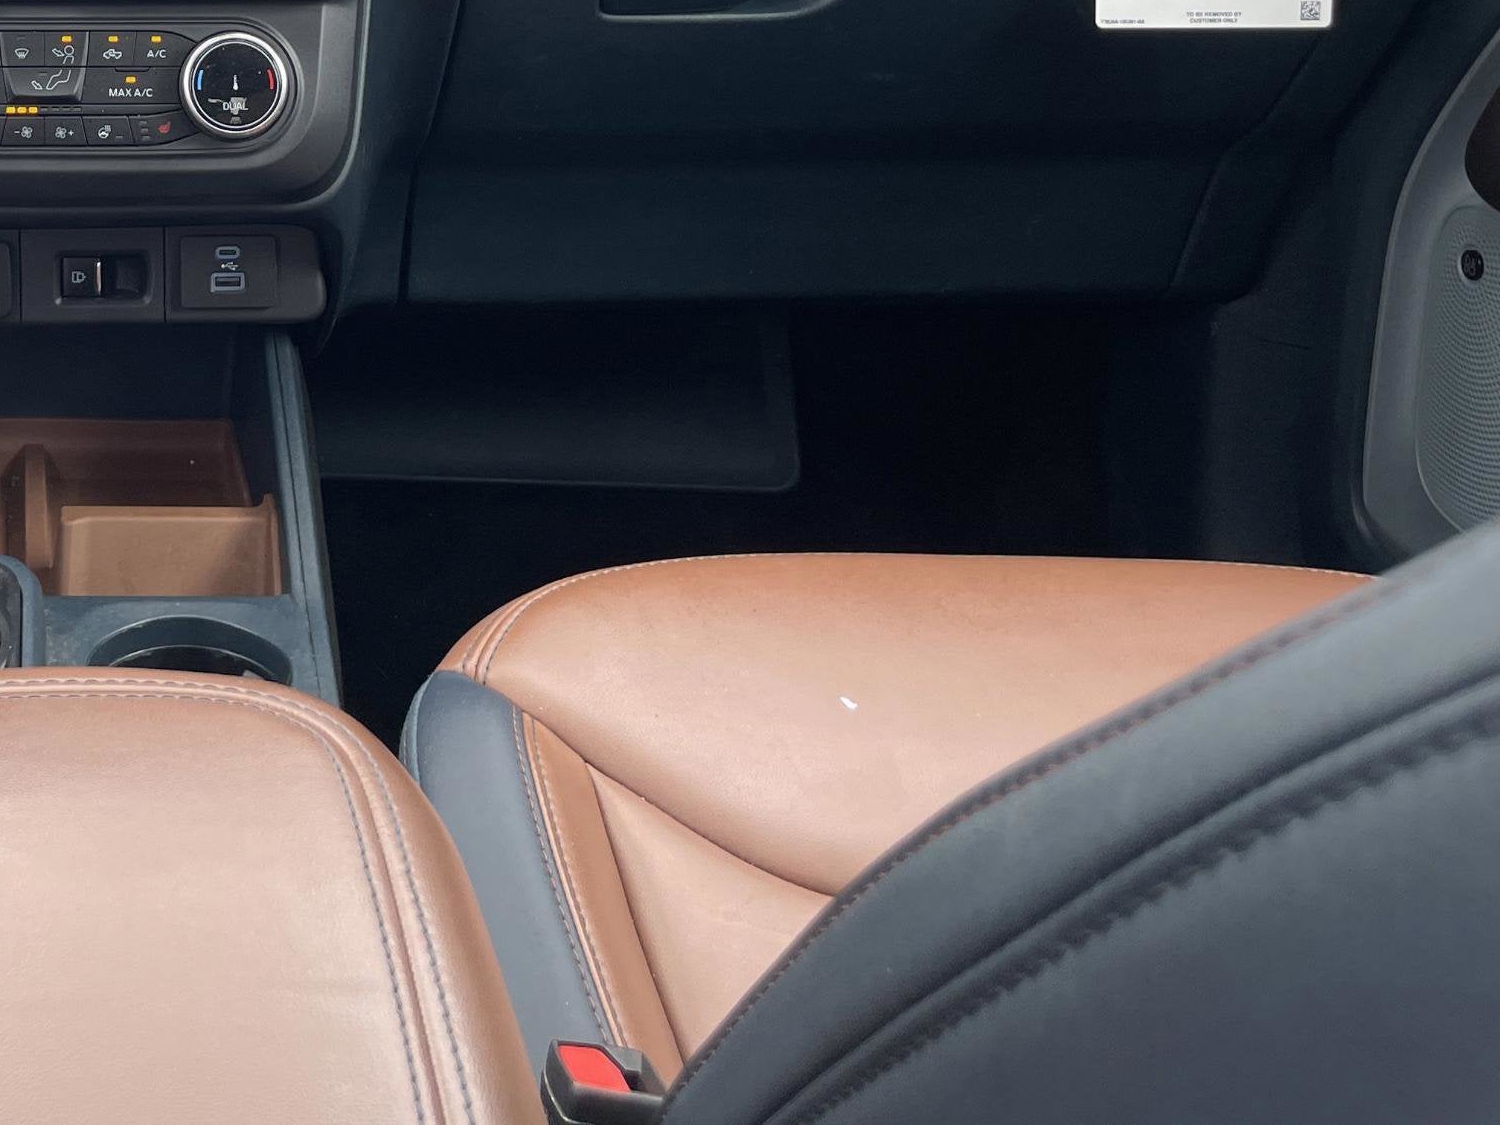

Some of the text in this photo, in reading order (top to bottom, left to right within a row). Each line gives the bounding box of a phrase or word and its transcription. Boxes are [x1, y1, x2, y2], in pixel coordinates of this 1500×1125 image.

[147, 49, 167, 59] A/C
[108, 87, 153, 98] MAX A/C
[222, 102, 249, 111] DUAL
